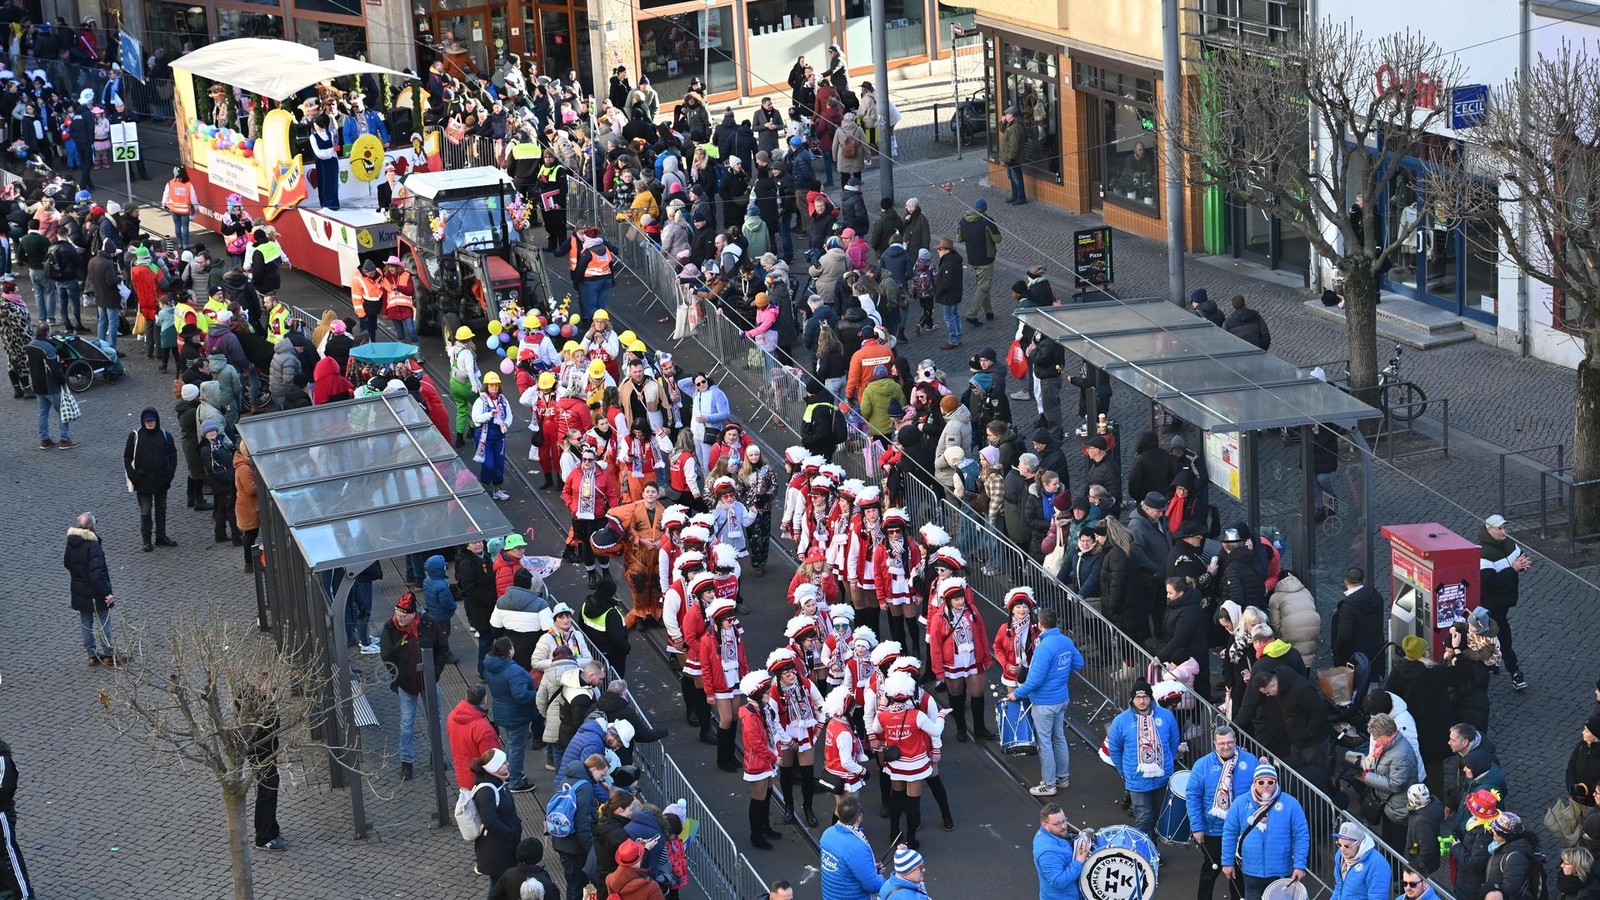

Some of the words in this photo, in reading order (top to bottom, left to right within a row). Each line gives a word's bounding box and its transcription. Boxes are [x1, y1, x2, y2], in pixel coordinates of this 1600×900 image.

[1454, 101, 1485, 114] CECIL
[116, 145, 136, 160] 25
[1101, 858, 1117, 867] VOM
[1119, 858, 1135, 869] KKH
